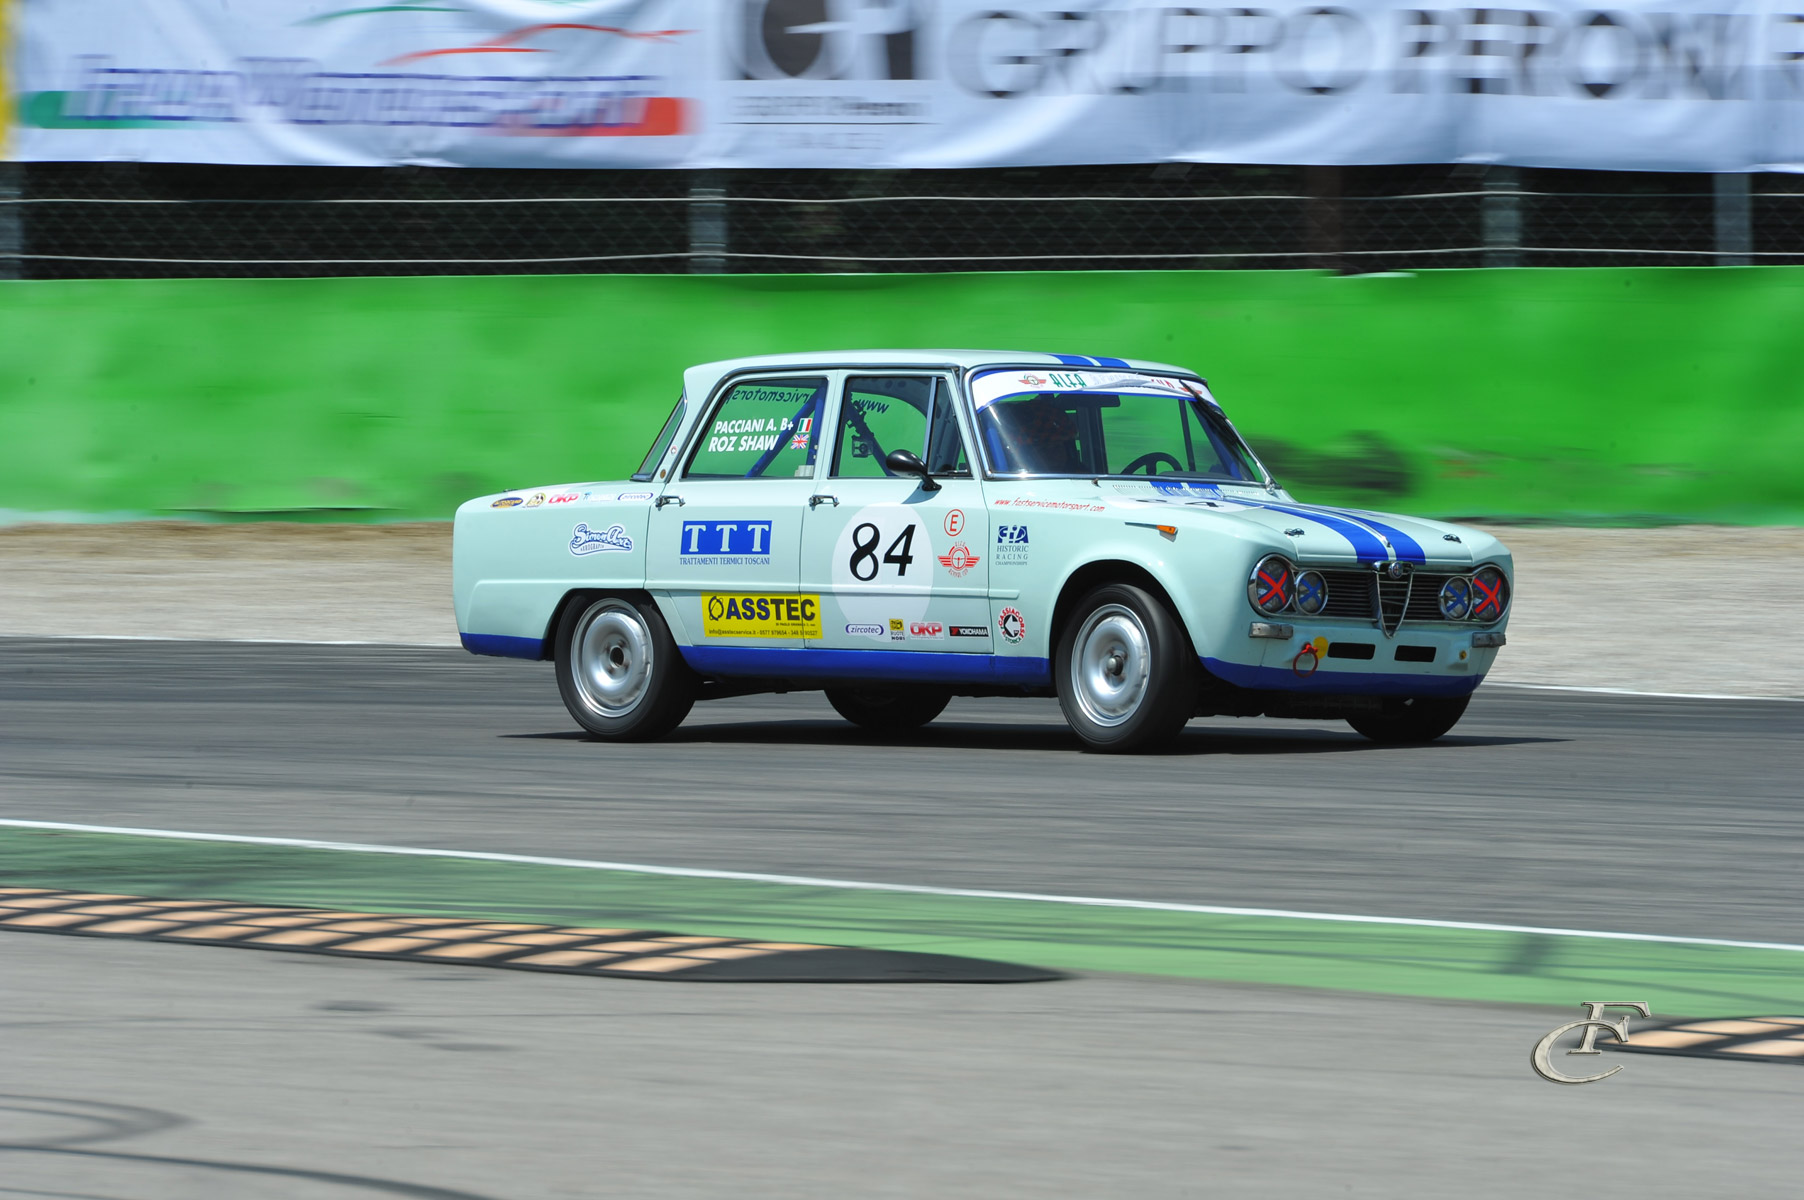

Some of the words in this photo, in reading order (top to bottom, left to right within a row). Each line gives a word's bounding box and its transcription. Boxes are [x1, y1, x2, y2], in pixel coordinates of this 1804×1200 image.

[947, 8, 1374, 98] GRUPPO
[1391, 9, 1746, 101] PERONI
[1048, 373, 1088, 388] ALFA
[714, 419, 765, 434] PACCIANI
[766, 418, 777, 431] A.
[780, 418, 794, 431] B+
[708, 436, 738, 452] ROZ
[738, 434, 780, 451] SHAW
[950, 514, 959, 531] E
[850, 522, 916, 581] 84
[680, 557, 718, 565] TRATTAMENTI
[720, 557, 742, 565] TERMICI
[745, 557, 770, 565] TOSCANI
[725, 598, 816, 621] ASSTEC
[851, 626, 880, 634] zircotec
[910, 622, 943, 637] OKP
[959, 628, 988, 636] YOKOHAMA
